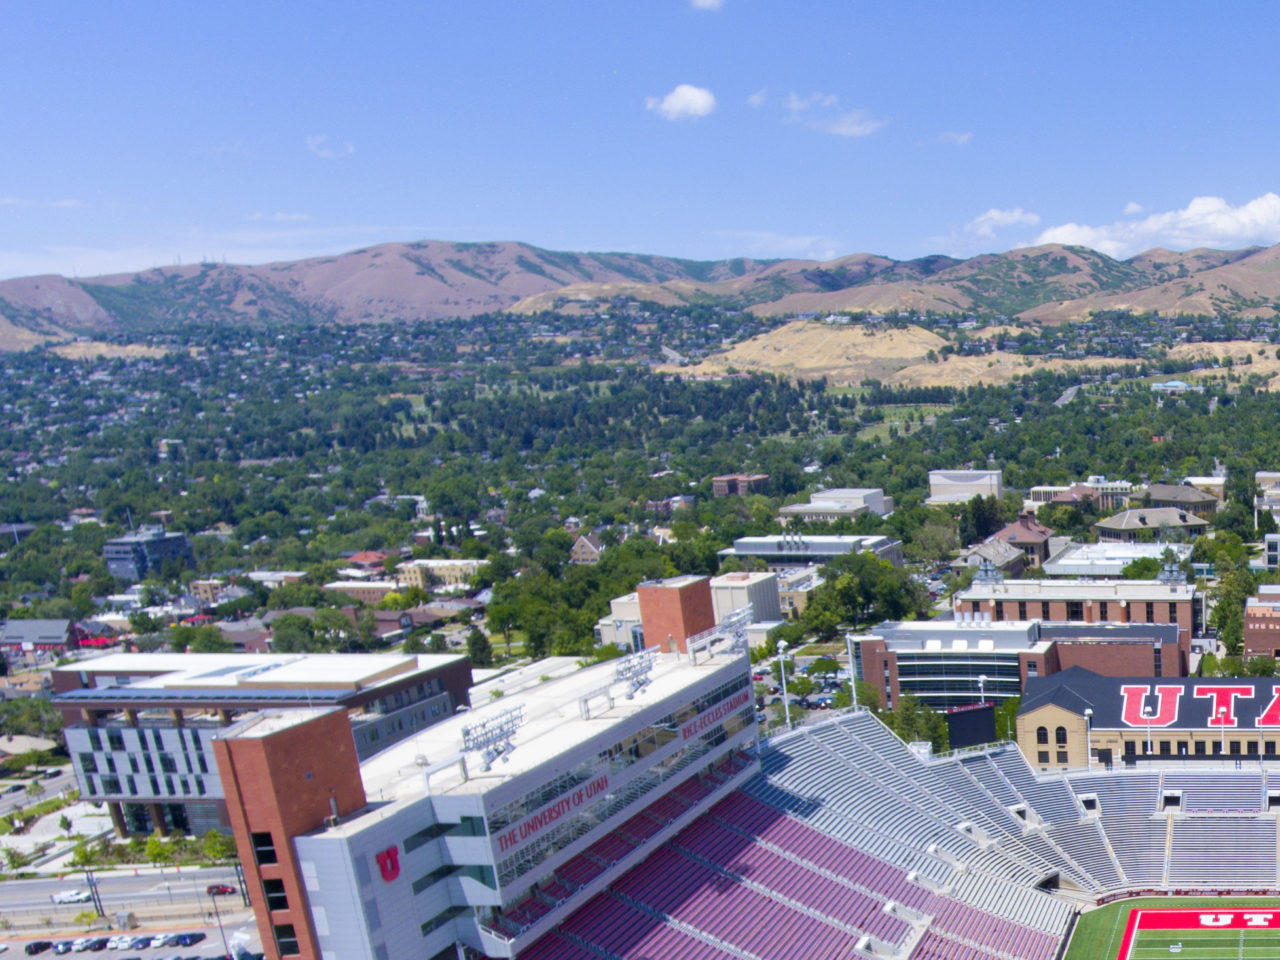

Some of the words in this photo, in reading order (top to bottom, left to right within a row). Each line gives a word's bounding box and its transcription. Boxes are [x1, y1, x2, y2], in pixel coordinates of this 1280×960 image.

[497, 828, 518, 852] THE
[519, 796, 572, 839] UNIVERSITY
[572, 789, 584, 808] OF
[585, 775, 609, 799] UTAH
[376, 845, 400, 882] U
[1168, 945, 1182, 953] 10
